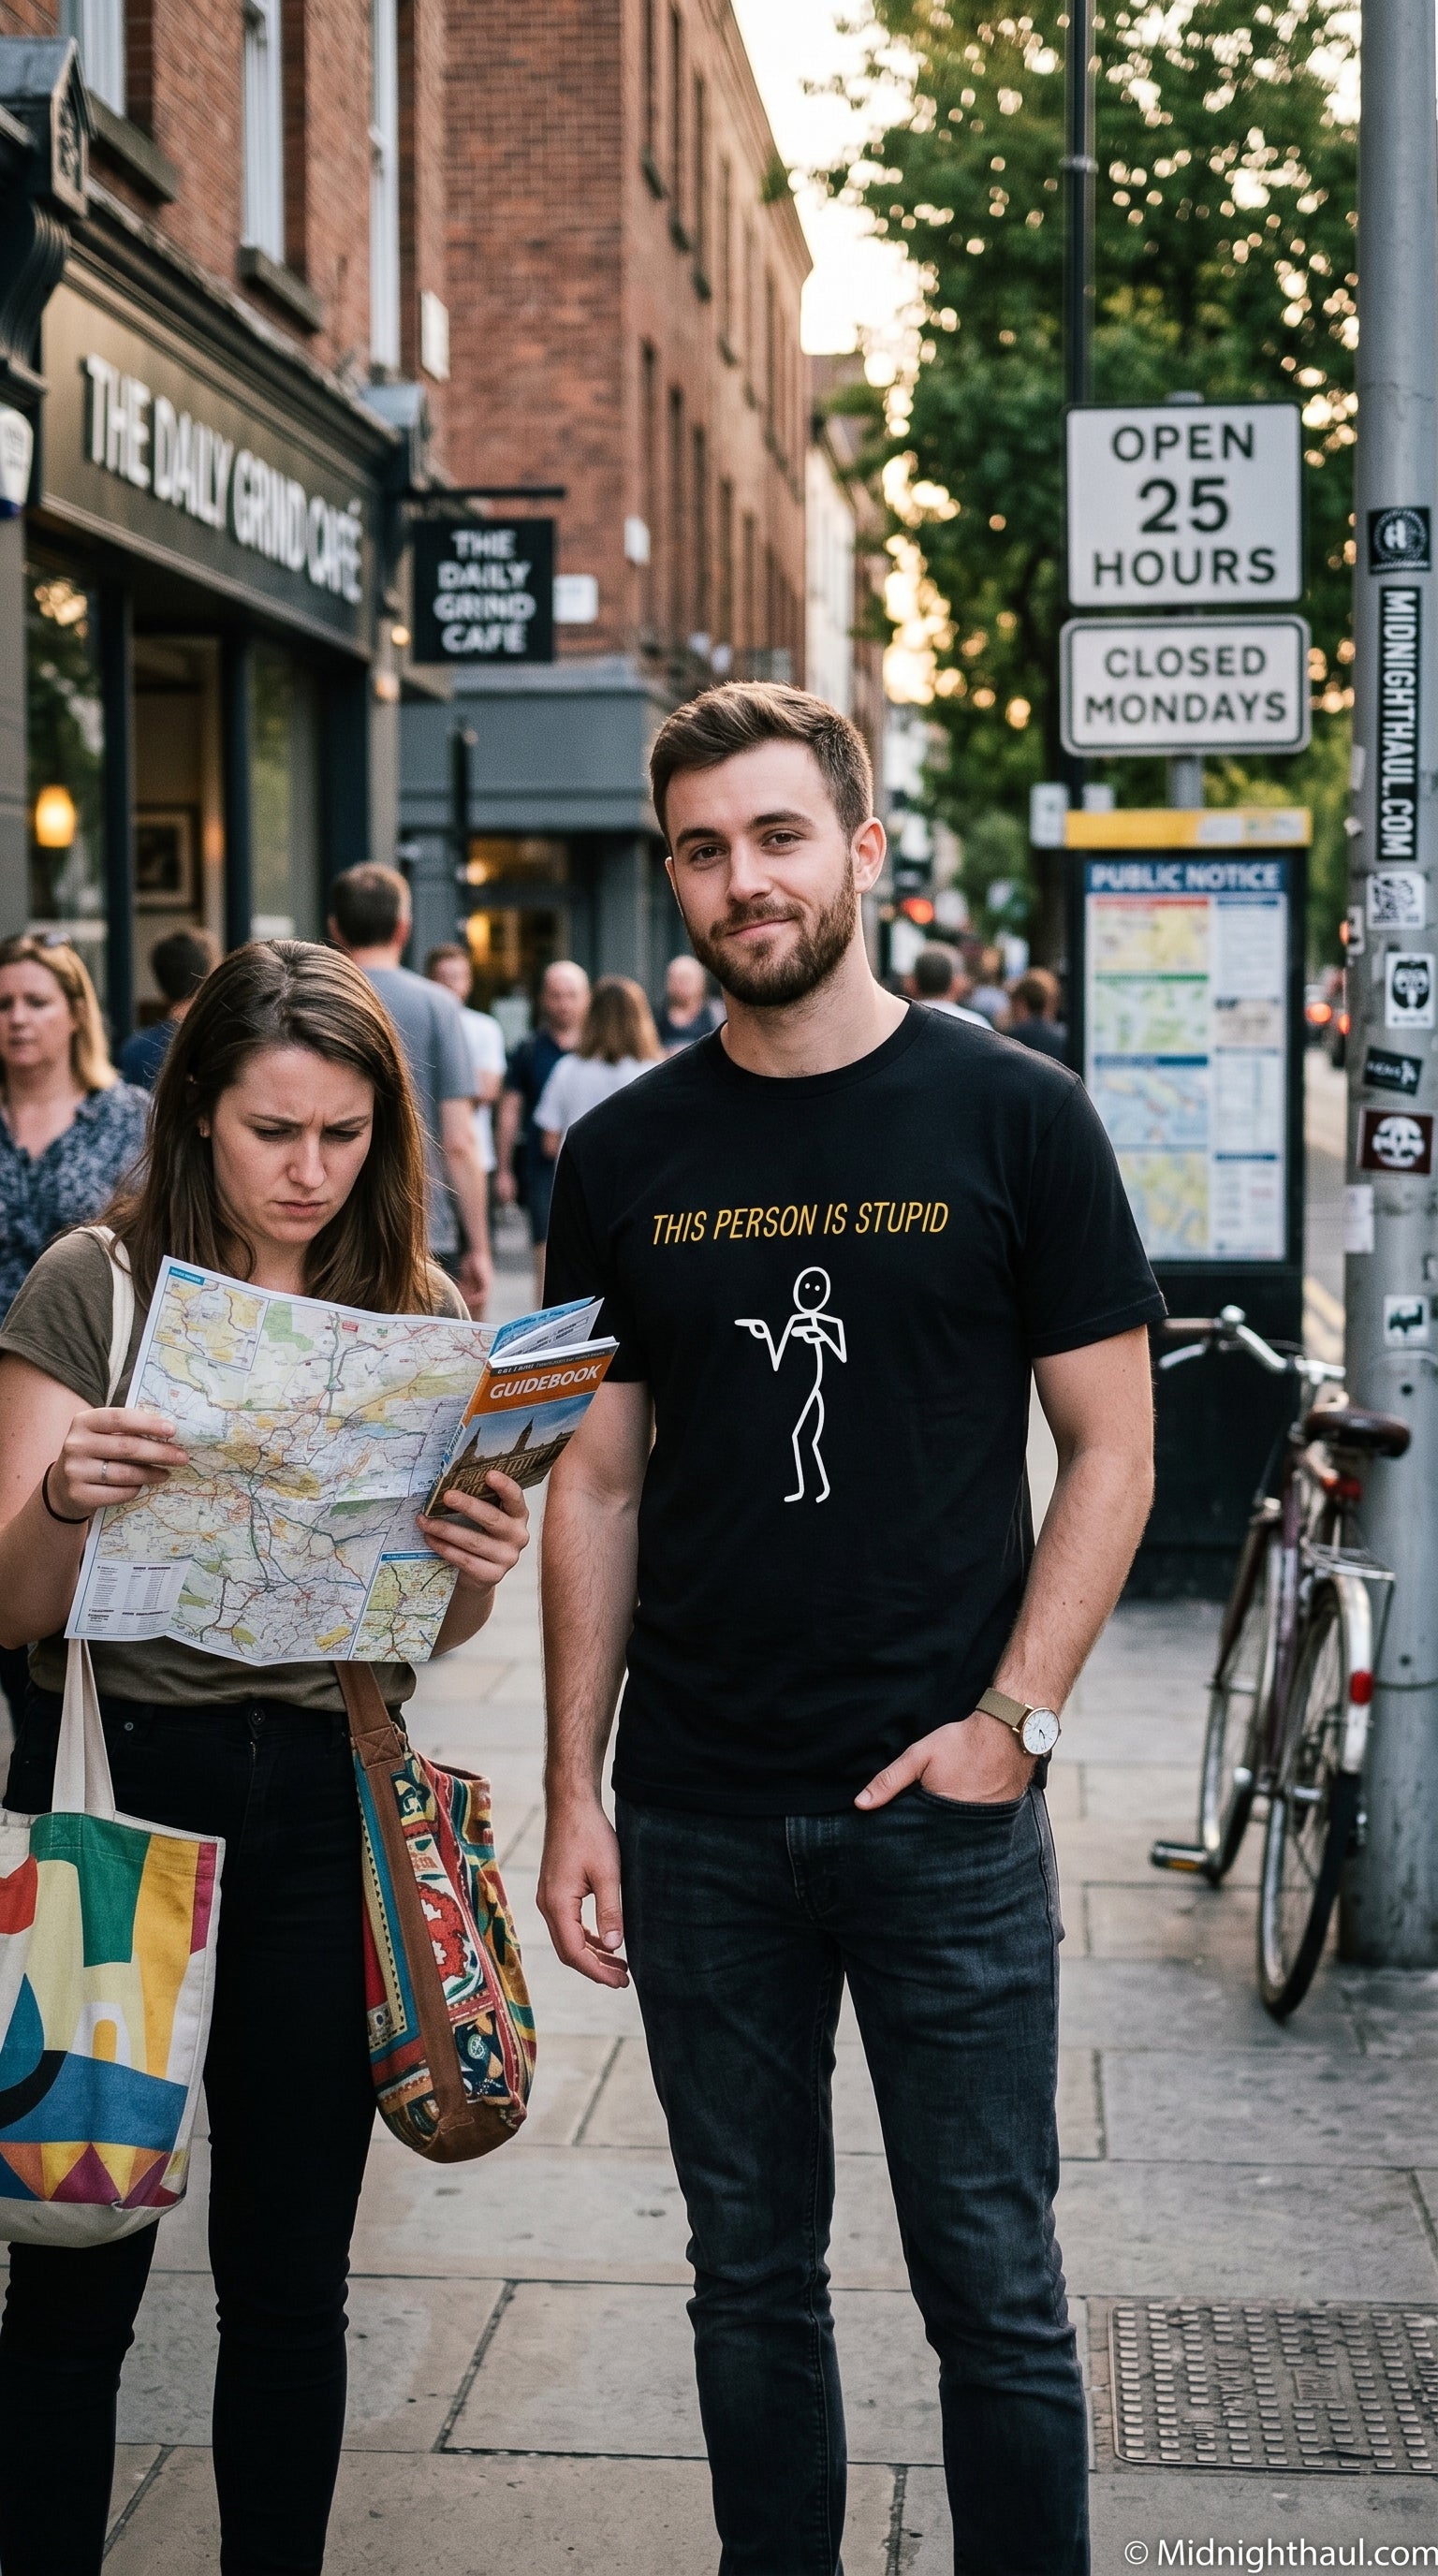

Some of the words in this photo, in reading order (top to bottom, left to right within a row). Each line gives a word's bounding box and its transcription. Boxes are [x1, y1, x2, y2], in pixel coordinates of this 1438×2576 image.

[1111, 423, 1255, 462] OPEN
[87, 352, 151, 488] THE
[154, 396, 234, 531] DAILY
[234, 449, 307, 572] GRIND
[307, 498, 363, 604] CAFÉ
[1138, 477, 1229, 534] 25
[451, 530, 516, 559] THE
[437, 561, 532, 590] DAILY
[1093, 548, 1276, 587] HOURS
[433, 592, 536, 622] GRIND
[1105, 646, 1268, 680] CLOSED
[1084, 690, 1287, 724] MONDAYS
[1381, 590, 1416, 857] MIDNIGHTHAUL.COM
[1091, 863, 1182, 890] PUBLIC
[1185, 863, 1280, 890] NOTICE
[653, 1210, 707, 1246] THIS
[713, 1205, 817, 1240] PERSON
[823, 1203, 847, 1235] IS
[855, 1201, 949, 1234] STUPID
[490, 1364, 603, 1400] GUIDEBOOK
